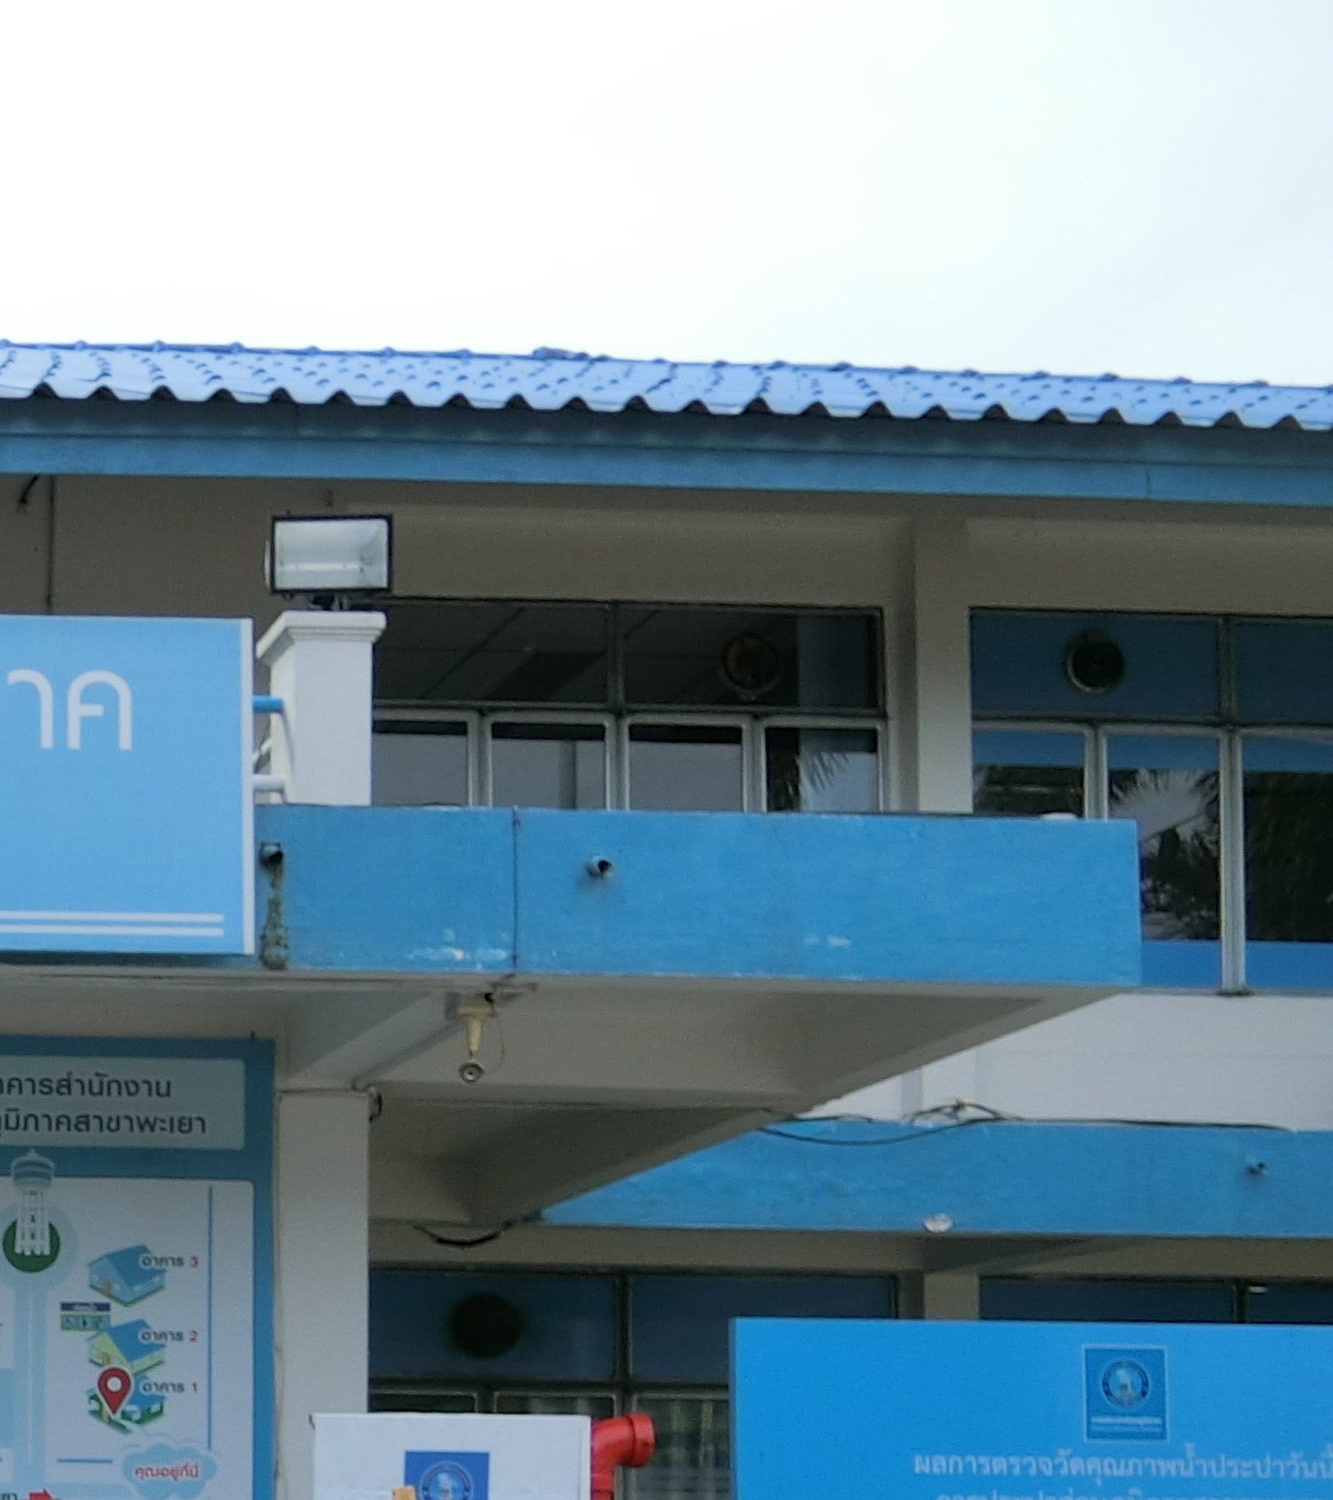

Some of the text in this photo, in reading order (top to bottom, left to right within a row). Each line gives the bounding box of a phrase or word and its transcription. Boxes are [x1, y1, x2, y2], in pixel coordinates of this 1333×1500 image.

[142, 1256, 198, 1268] อาคาร 3
[142, 1330, 198, 1342] อาคาร 2
[142, 1381, 197, 1393] อาคาร 1
[135, 1463, 199, 1482] คุณอยู่ที่นี่
